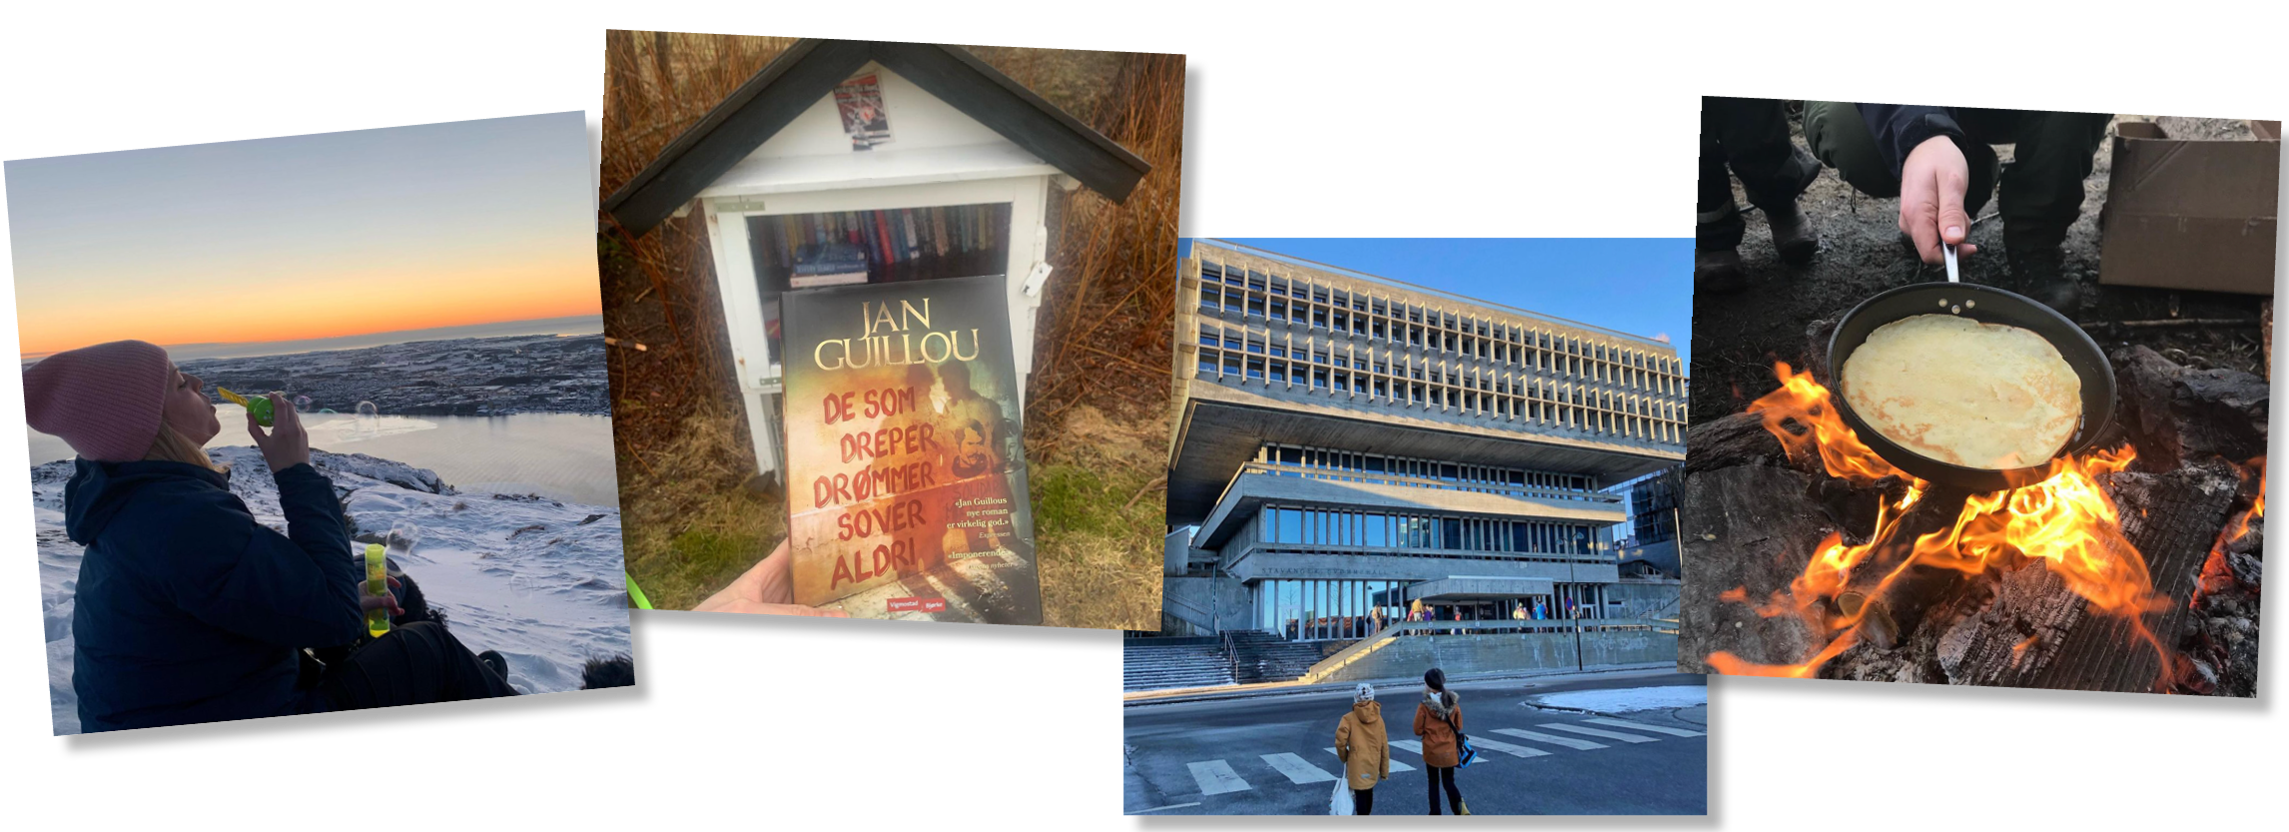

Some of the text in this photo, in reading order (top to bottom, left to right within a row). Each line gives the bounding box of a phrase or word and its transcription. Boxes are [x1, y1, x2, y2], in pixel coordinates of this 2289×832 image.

[857, 297, 931, 341] JAN
[814, 328, 980, 371] GUILLOU
[823, 386, 916, 425] DE SOM
[840, 422, 938, 464] DREPER
[813, 463, 936, 509] DRØMMER
[973, 497, 1008, 506] Guillous
[838, 499, 926, 541] SOVER
[956, 519, 987, 529] virkelig
[966, 509, 980, 518] nye
[982, 508, 1008, 516] roman
[830, 537, 916, 591] ALDRI
[1327, 568, 1388, 577] SVØMMHALL
